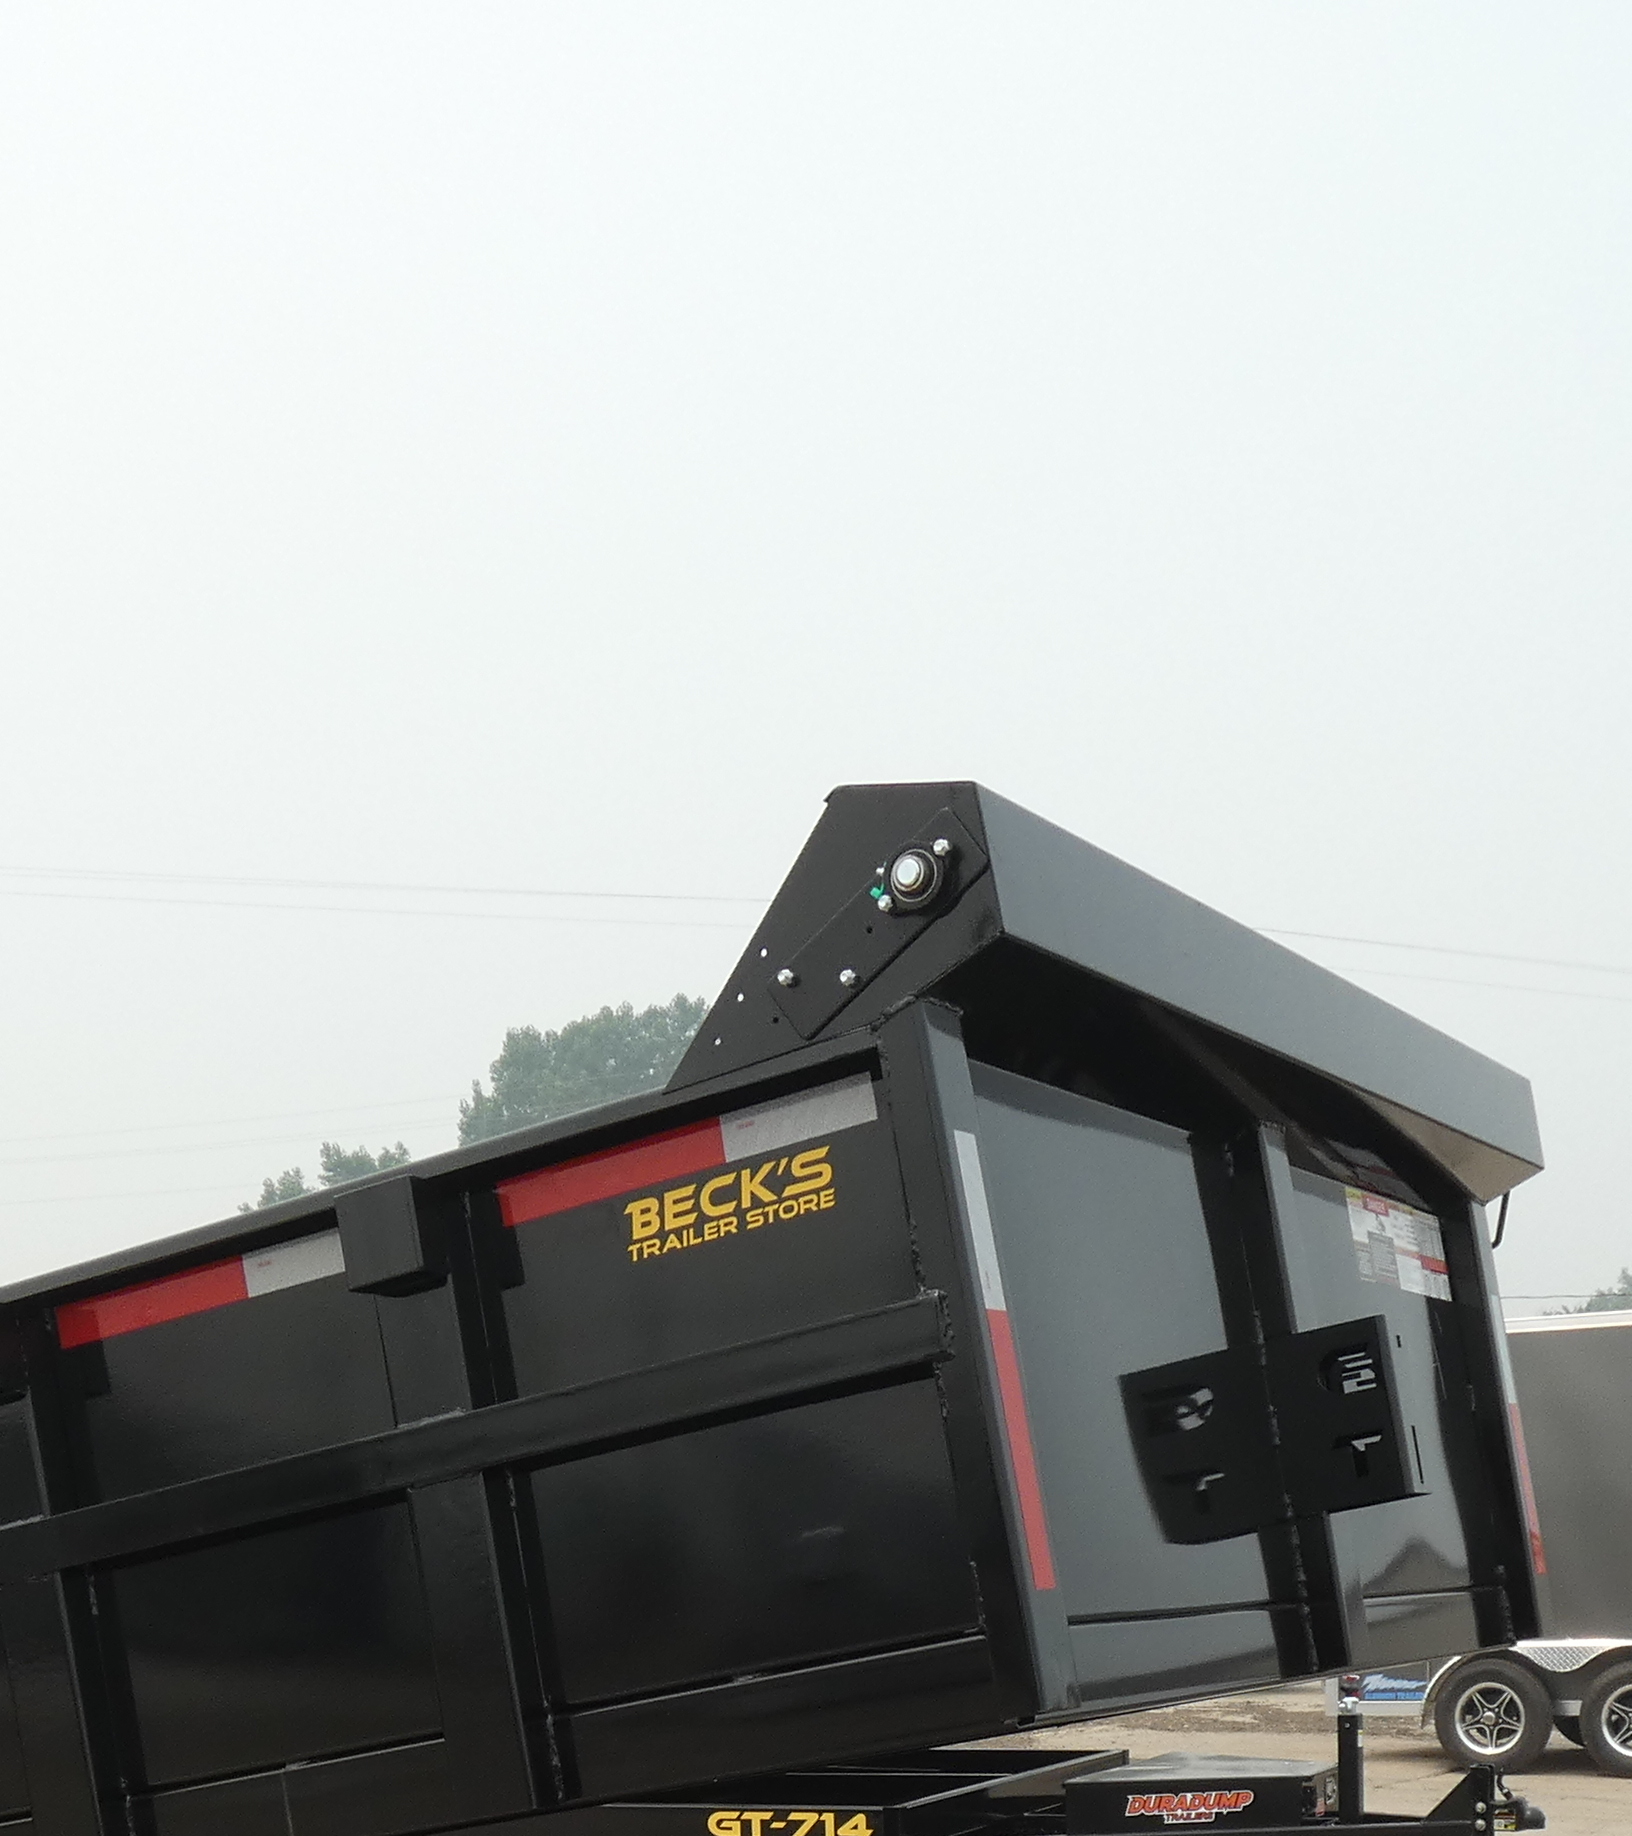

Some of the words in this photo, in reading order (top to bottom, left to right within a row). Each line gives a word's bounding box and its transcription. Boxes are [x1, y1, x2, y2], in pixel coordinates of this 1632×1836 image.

[624, 1145, 834, 1240] BECK'S
[627, 1215, 739, 1262] TRAILER
[746, 1187, 837, 1230] STORE
[1126, 1791, 1253, 1814] DURADUMP
